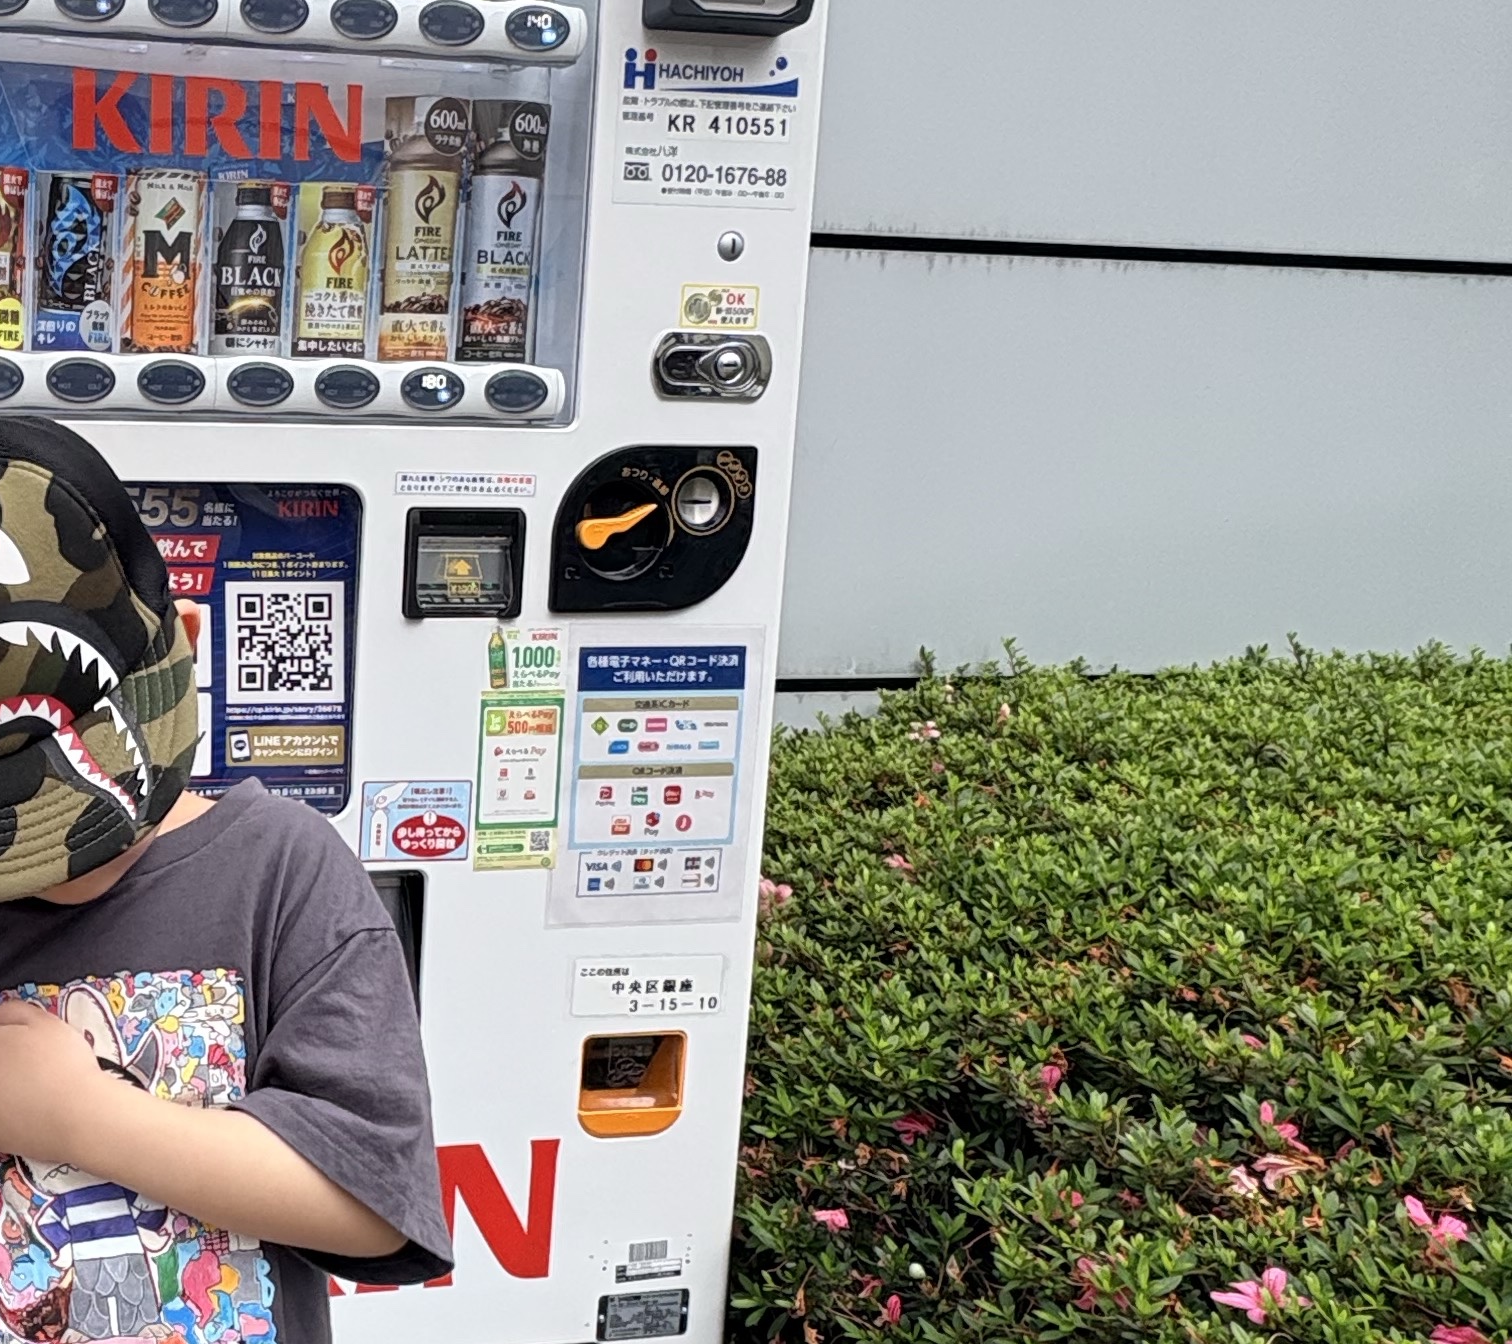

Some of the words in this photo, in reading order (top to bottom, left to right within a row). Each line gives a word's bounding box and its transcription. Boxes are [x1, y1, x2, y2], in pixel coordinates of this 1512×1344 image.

[526, 14, 552, 30] 140
[658, 62, 744, 82] HACHIYOH
[72, 66, 364, 163] KIRIN
[667, 113, 696, 133] KR
[708, 115, 787, 136] 410551
[661, 163, 787, 187] 0120-1676-88
[414, 226, 442, 238] FIRE
[496, 231, 523, 243] FIRE
[141, 230, 194, 279] M
[247, 255, 267, 265] FIRE
[395, 245, 452, 262] LATTE
[477, 249, 532, 266] BLACK
[220, 265, 283, 288] BLACK
[325, 277, 354, 290] FIRE
[726, 292, 746, 306] OK
[36, 333, 57, 346] キレ
[203, 501, 235, 514] 名様に
[278, 499, 340, 518] KIRIN
[201, 515, 239, 527] 当たる!
[531, 632, 558, 641] KIRIN
[586, 654, 739, 669] 各種電子マネー・QRコード決済
[512, 669, 561, 679] えらべるPay
[613, 669, 713, 684] ご利用いただけます。
[508, 709, 555, 720] えらべるPay
[254, 735, 281, 747] LINE
[282, 735, 340, 747] アカウントで
[253, 747, 339, 758] キャンペーンにログイン!
[530, 746, 547, 757] Pay
[396, 826, 462, 840] 少し待ってから
[644, 827, 659, 837] Pay
[585, 862, 609, 872] VISA
[580, 967, 630, 977] ここの住所は
[611, 978, 694, 995] 中央区銀座
